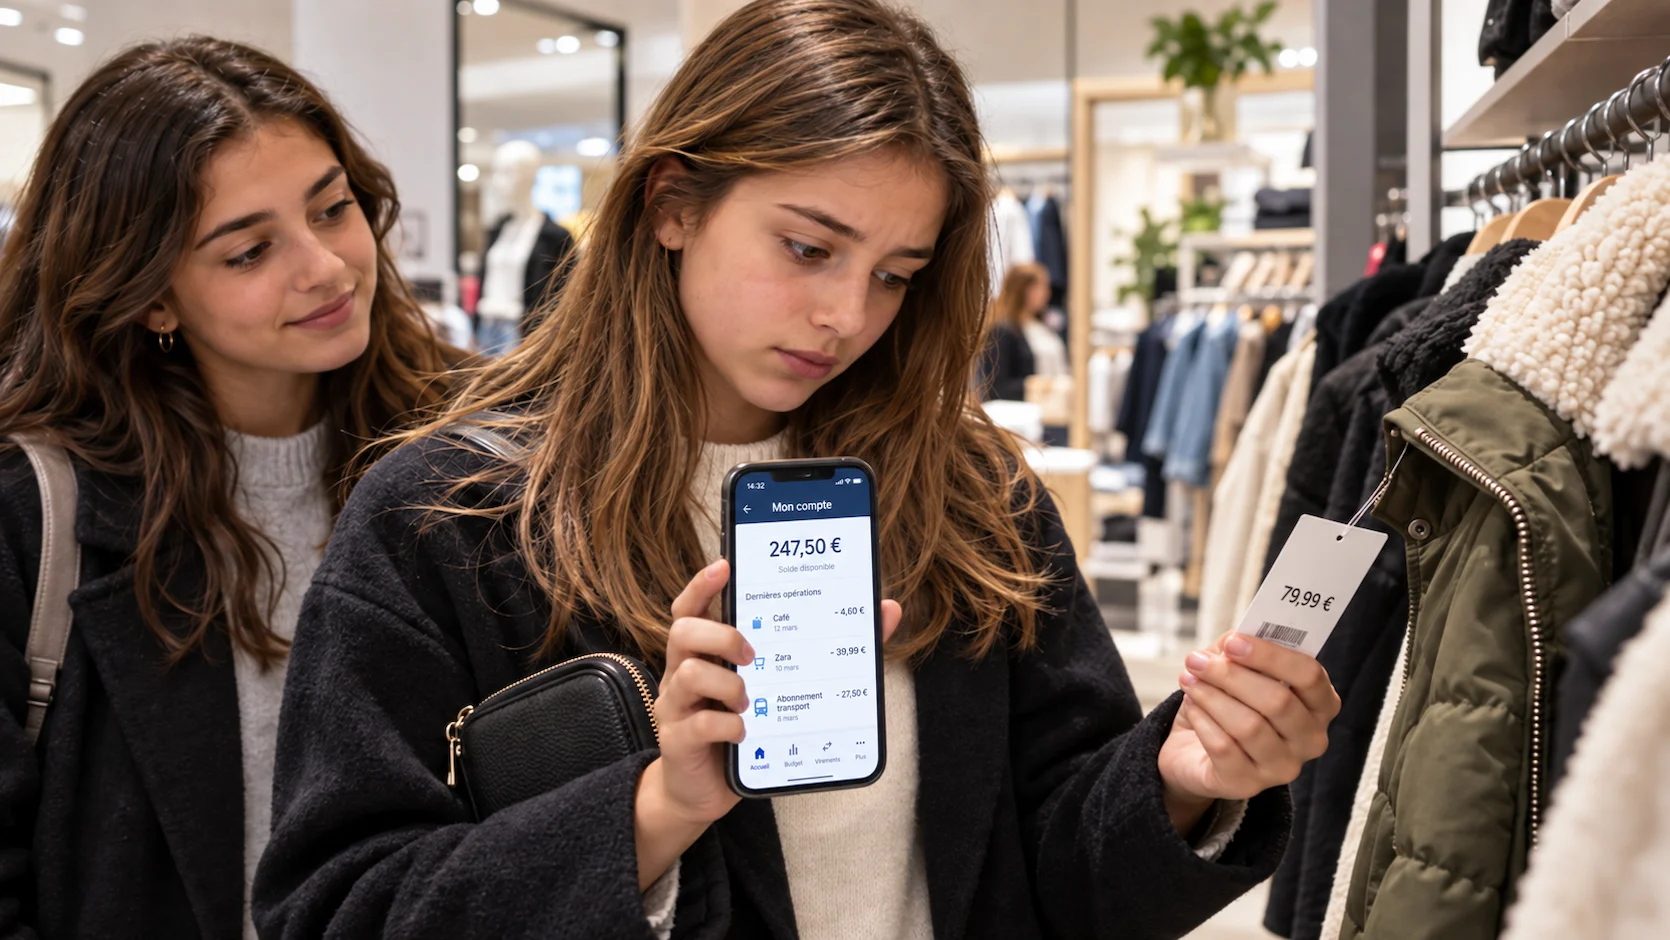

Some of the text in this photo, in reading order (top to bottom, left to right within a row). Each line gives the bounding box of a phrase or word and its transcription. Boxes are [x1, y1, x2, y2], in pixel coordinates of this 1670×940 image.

[772, 501, 832, 512] Mon compte
[769, 537, 841, 558] 247,50 €
[778, 563, 835, 573] Solde disponible
[746, 588, 821, 601] Dernières opérations
[1281, 585, 1335, 611] 79,99 €
[840, 608, 857, 616] 4,60
[773, 614, 790, 622] Café
[836, 647, 859, 656] 39,99
[861, 646, 866, 654] €
[775, 654, 791, 662] Zara
[777, 692, 823, 703] Abonnement
[841, 690, 861, 699] 27,50
[777, 703, 810, 712] transport
[784, 760, 803, 768] Budget
